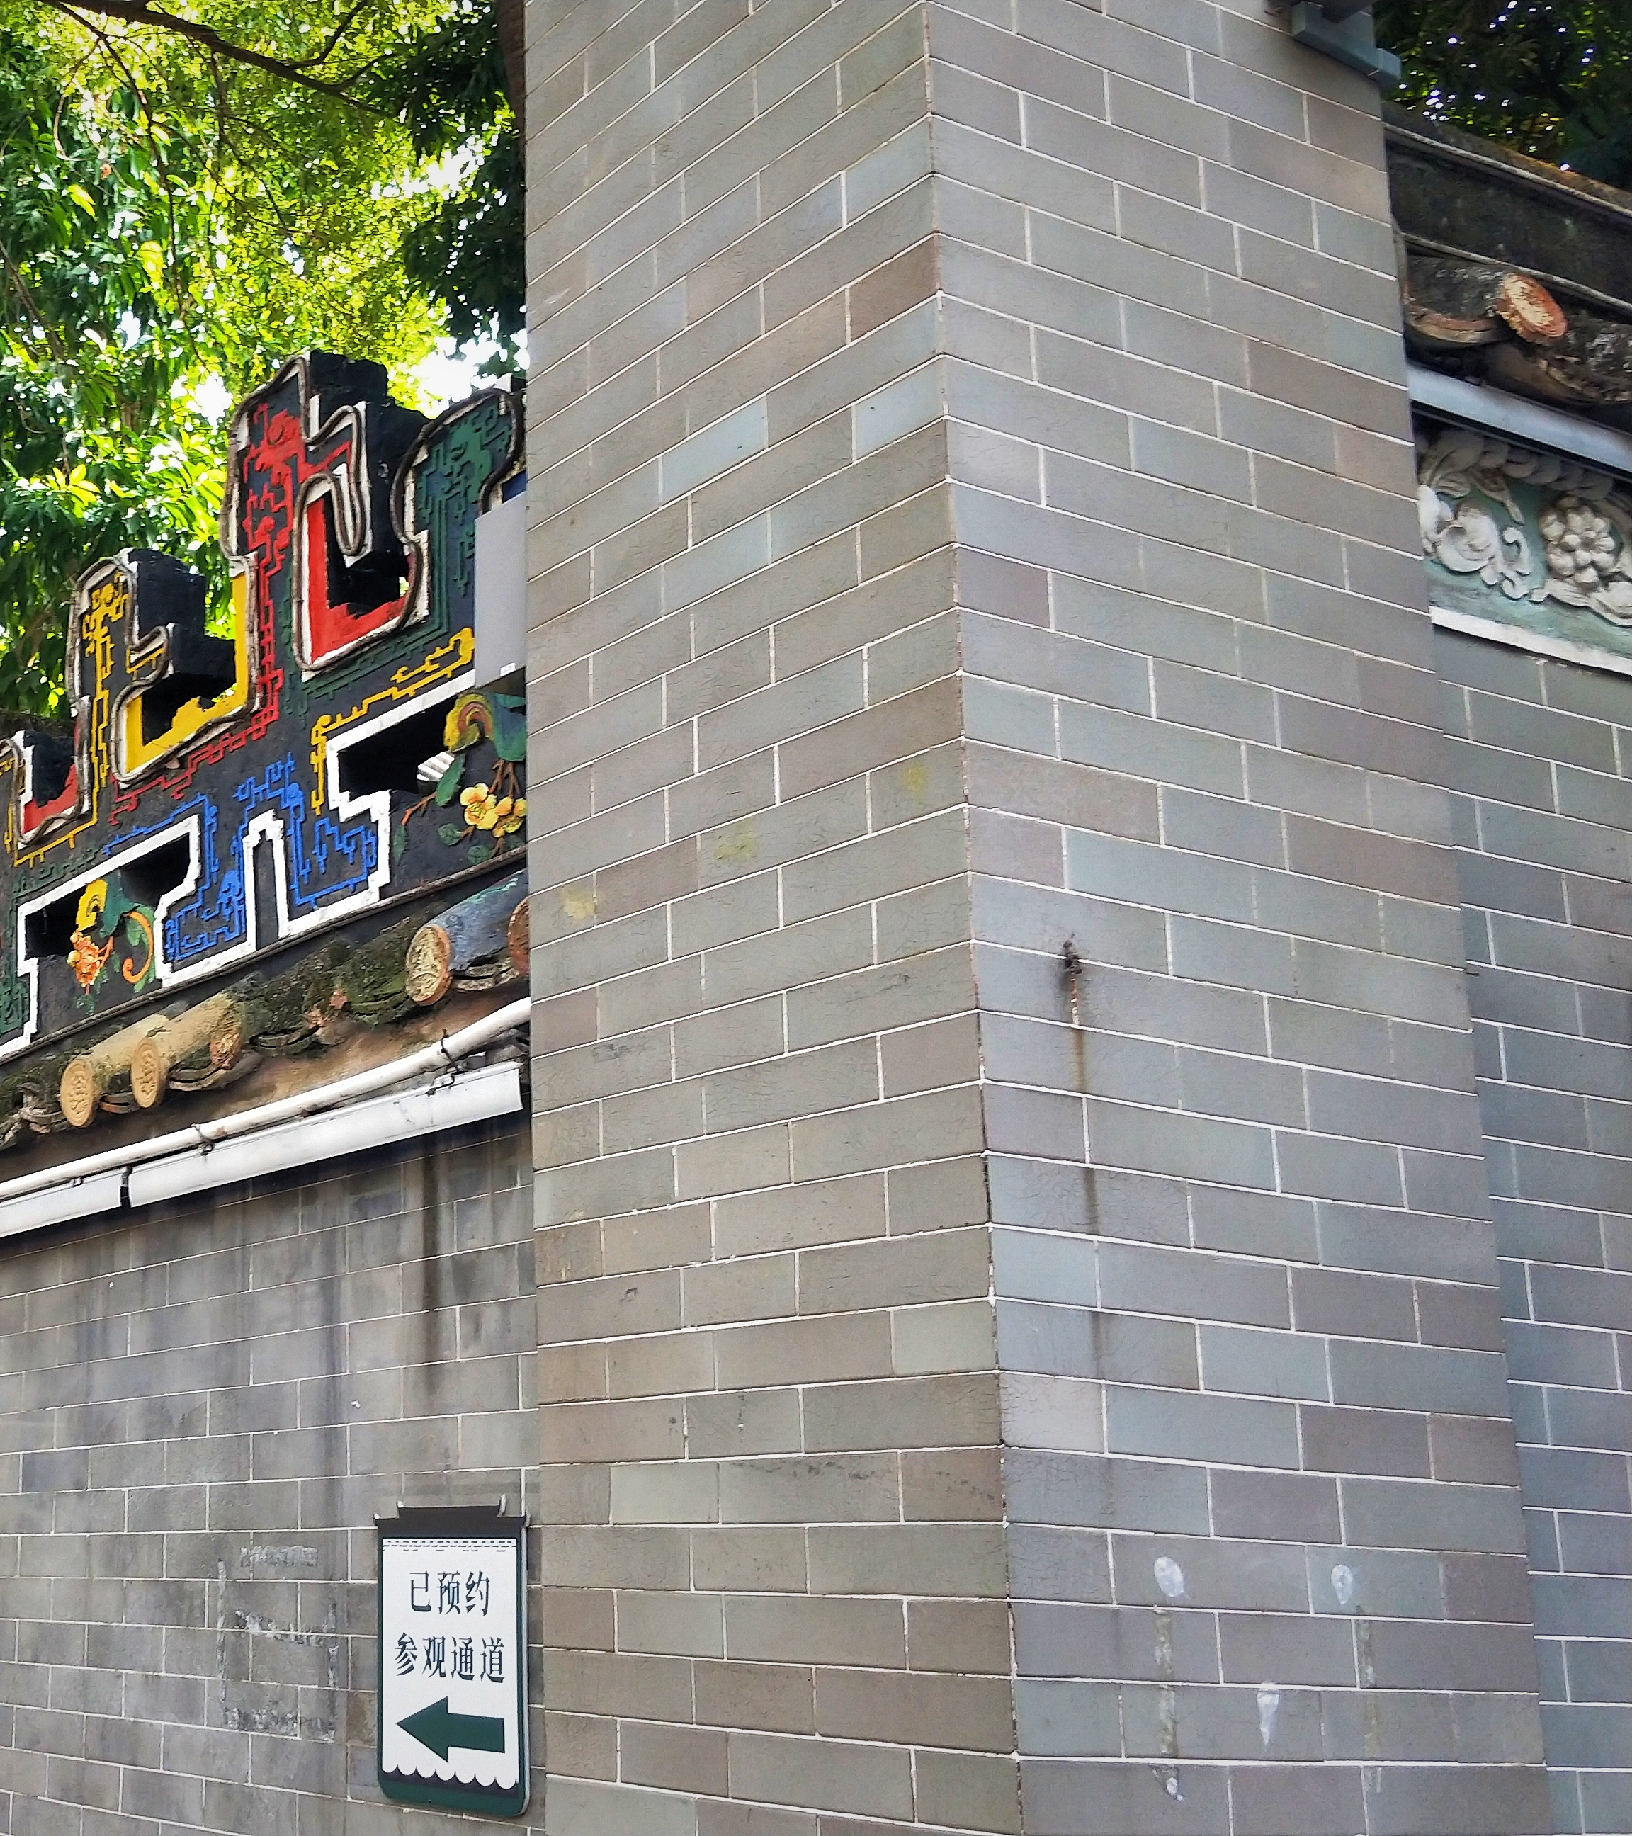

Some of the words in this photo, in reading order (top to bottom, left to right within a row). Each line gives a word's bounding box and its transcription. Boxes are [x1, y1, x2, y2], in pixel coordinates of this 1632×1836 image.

[409, 1570, 490, 1616] 已预约
[394, 1632, 505, 1683] 参观通道
